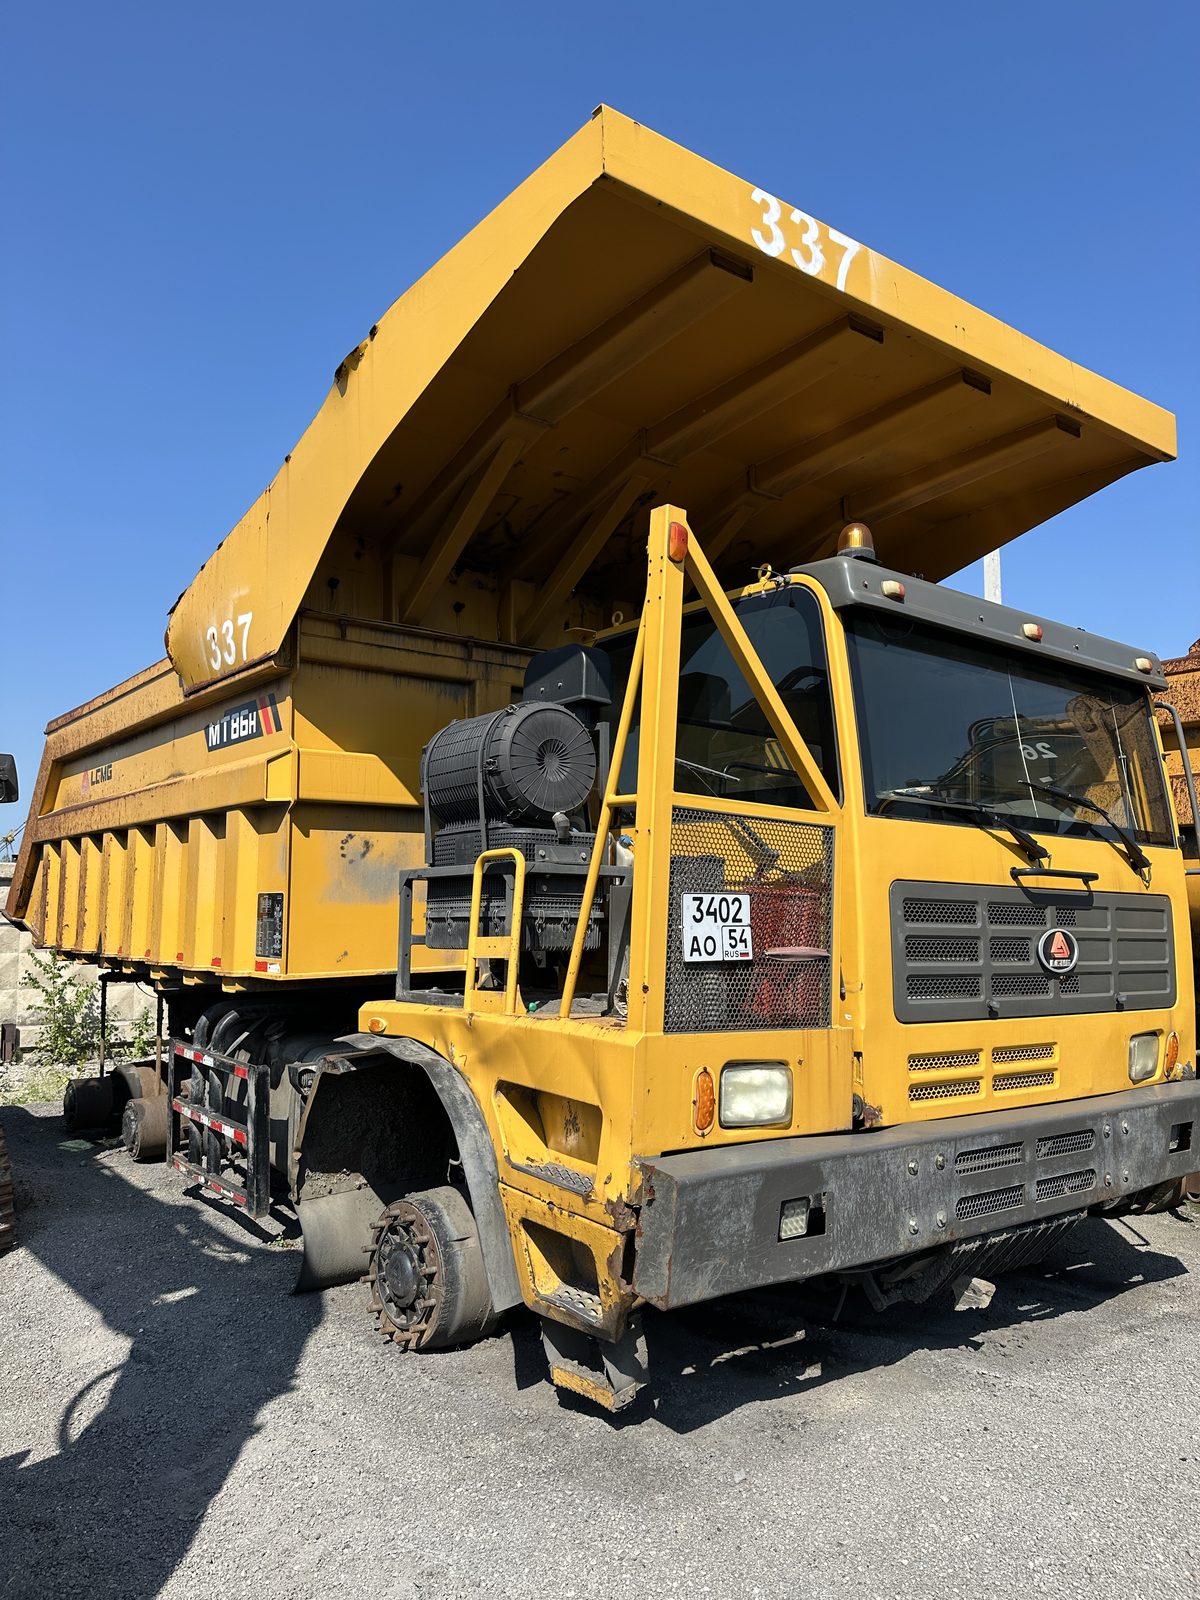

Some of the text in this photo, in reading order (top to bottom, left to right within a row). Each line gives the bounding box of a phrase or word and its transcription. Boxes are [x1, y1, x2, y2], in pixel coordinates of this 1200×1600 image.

[751, 187, 861, 292] 337
[206, 611, 253, 671] 337
[208, 709, 257, 747] MT86H
[692, 896, 743, 924] 3402
[724, 950, 740, 958] RUS
[728, 928, 748, 949] 54
